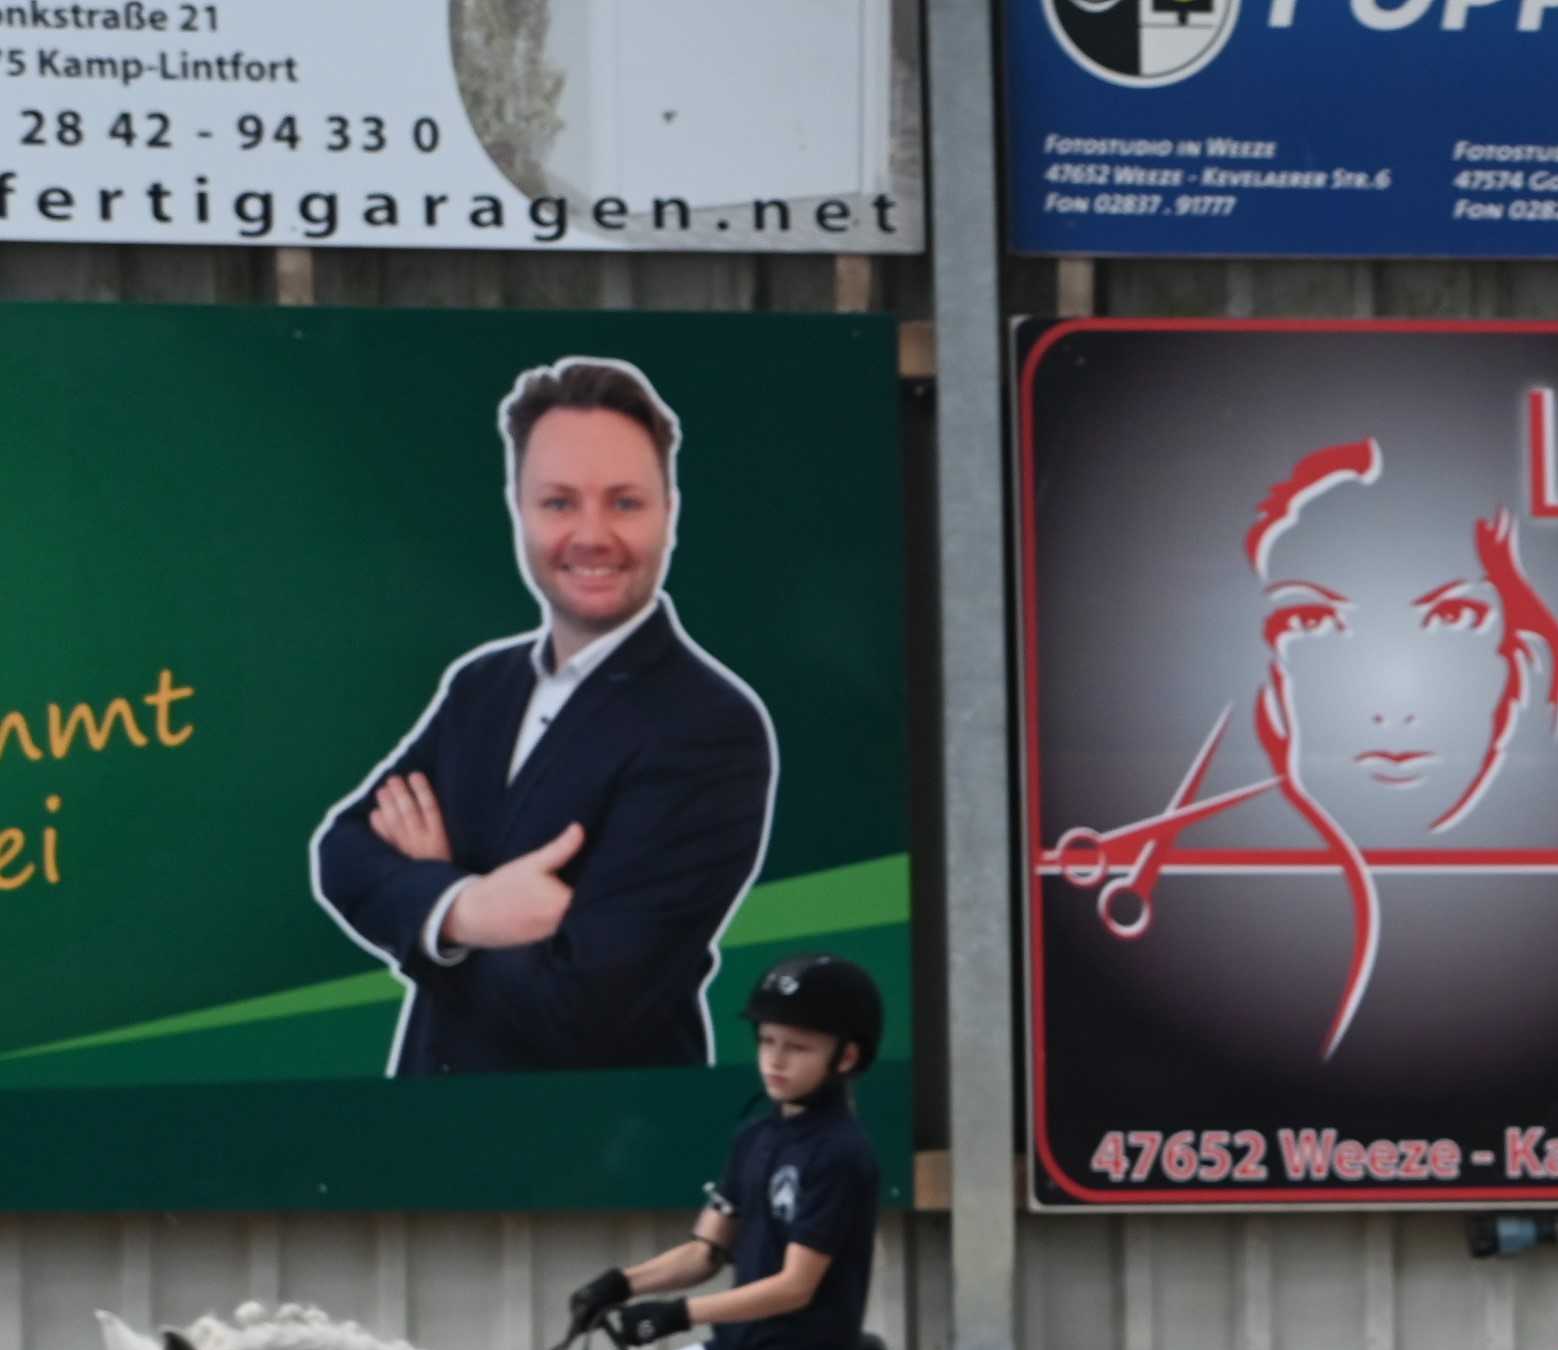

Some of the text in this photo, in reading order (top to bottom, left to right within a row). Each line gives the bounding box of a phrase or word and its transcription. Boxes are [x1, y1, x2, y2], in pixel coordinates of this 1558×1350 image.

[179, 3, 219, 32] 21
[0, 48, 299, 86] 5 Kamp-Lintfort
[20, 108, 84, 147] 28
[107, 111, 172, 149] 42
[236, 113, 302, 151] 94
[326, 116, 389, 152] 33
[412, 117, 441, 155] 0
[1044, 164, 1112, 185] 47652
[1453, 170, 1524, 191] 47574
[1093, 195, 1161, 215] 02837
[1090, 1129, 1268, 1182] 47652
[1277, 1126, 1462, 1179] Weeze
